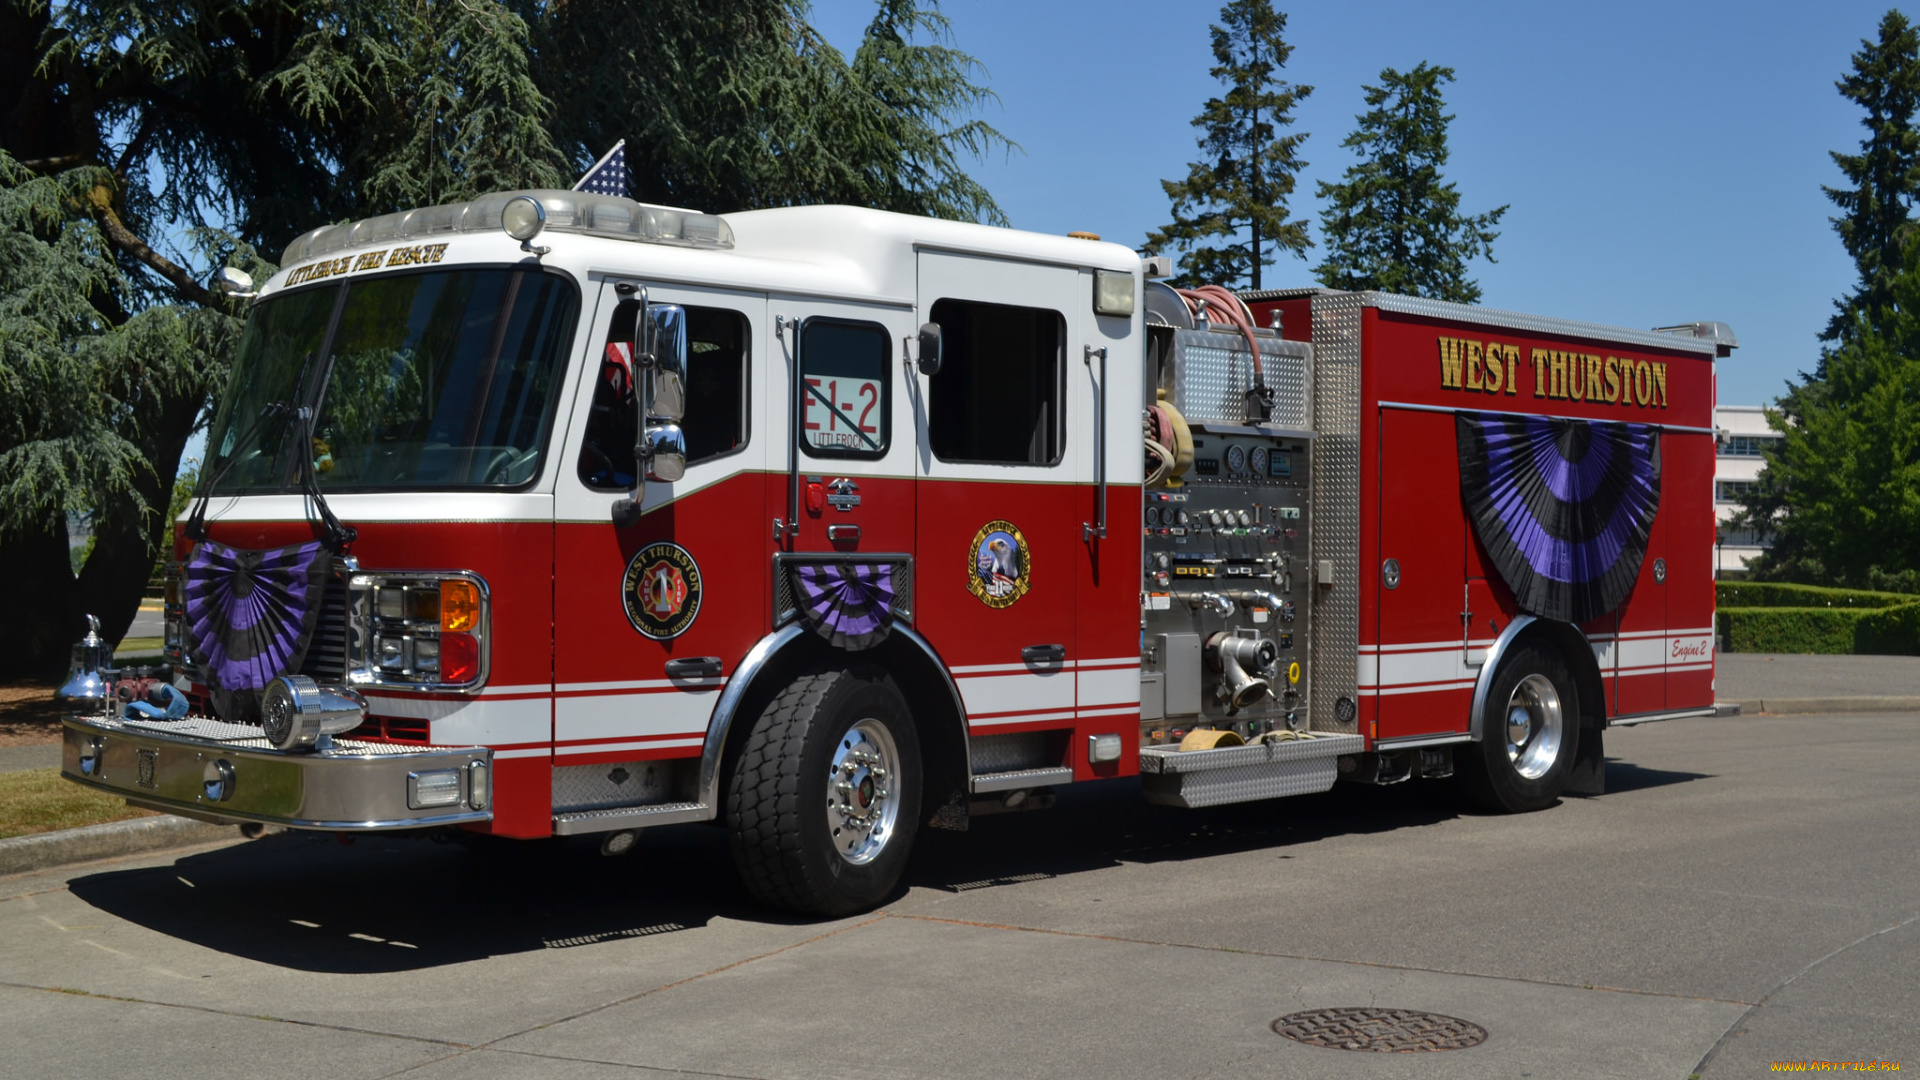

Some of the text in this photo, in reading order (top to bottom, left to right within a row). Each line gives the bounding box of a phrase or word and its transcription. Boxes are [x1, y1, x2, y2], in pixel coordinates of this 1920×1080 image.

[284, 243, 449, 288] LITTLEROCK FIRE RESCUE
[1438, 336, 1667, 408] WEST THURSTON
[804, 378, 878, 433] E1-2
[625, 546, 700, 592] WEST THURSTON
[627, 600, 698, 636] REGIONAL FIRE AUTHORITY
[1672, 639, 1707, 661] Engine 2
